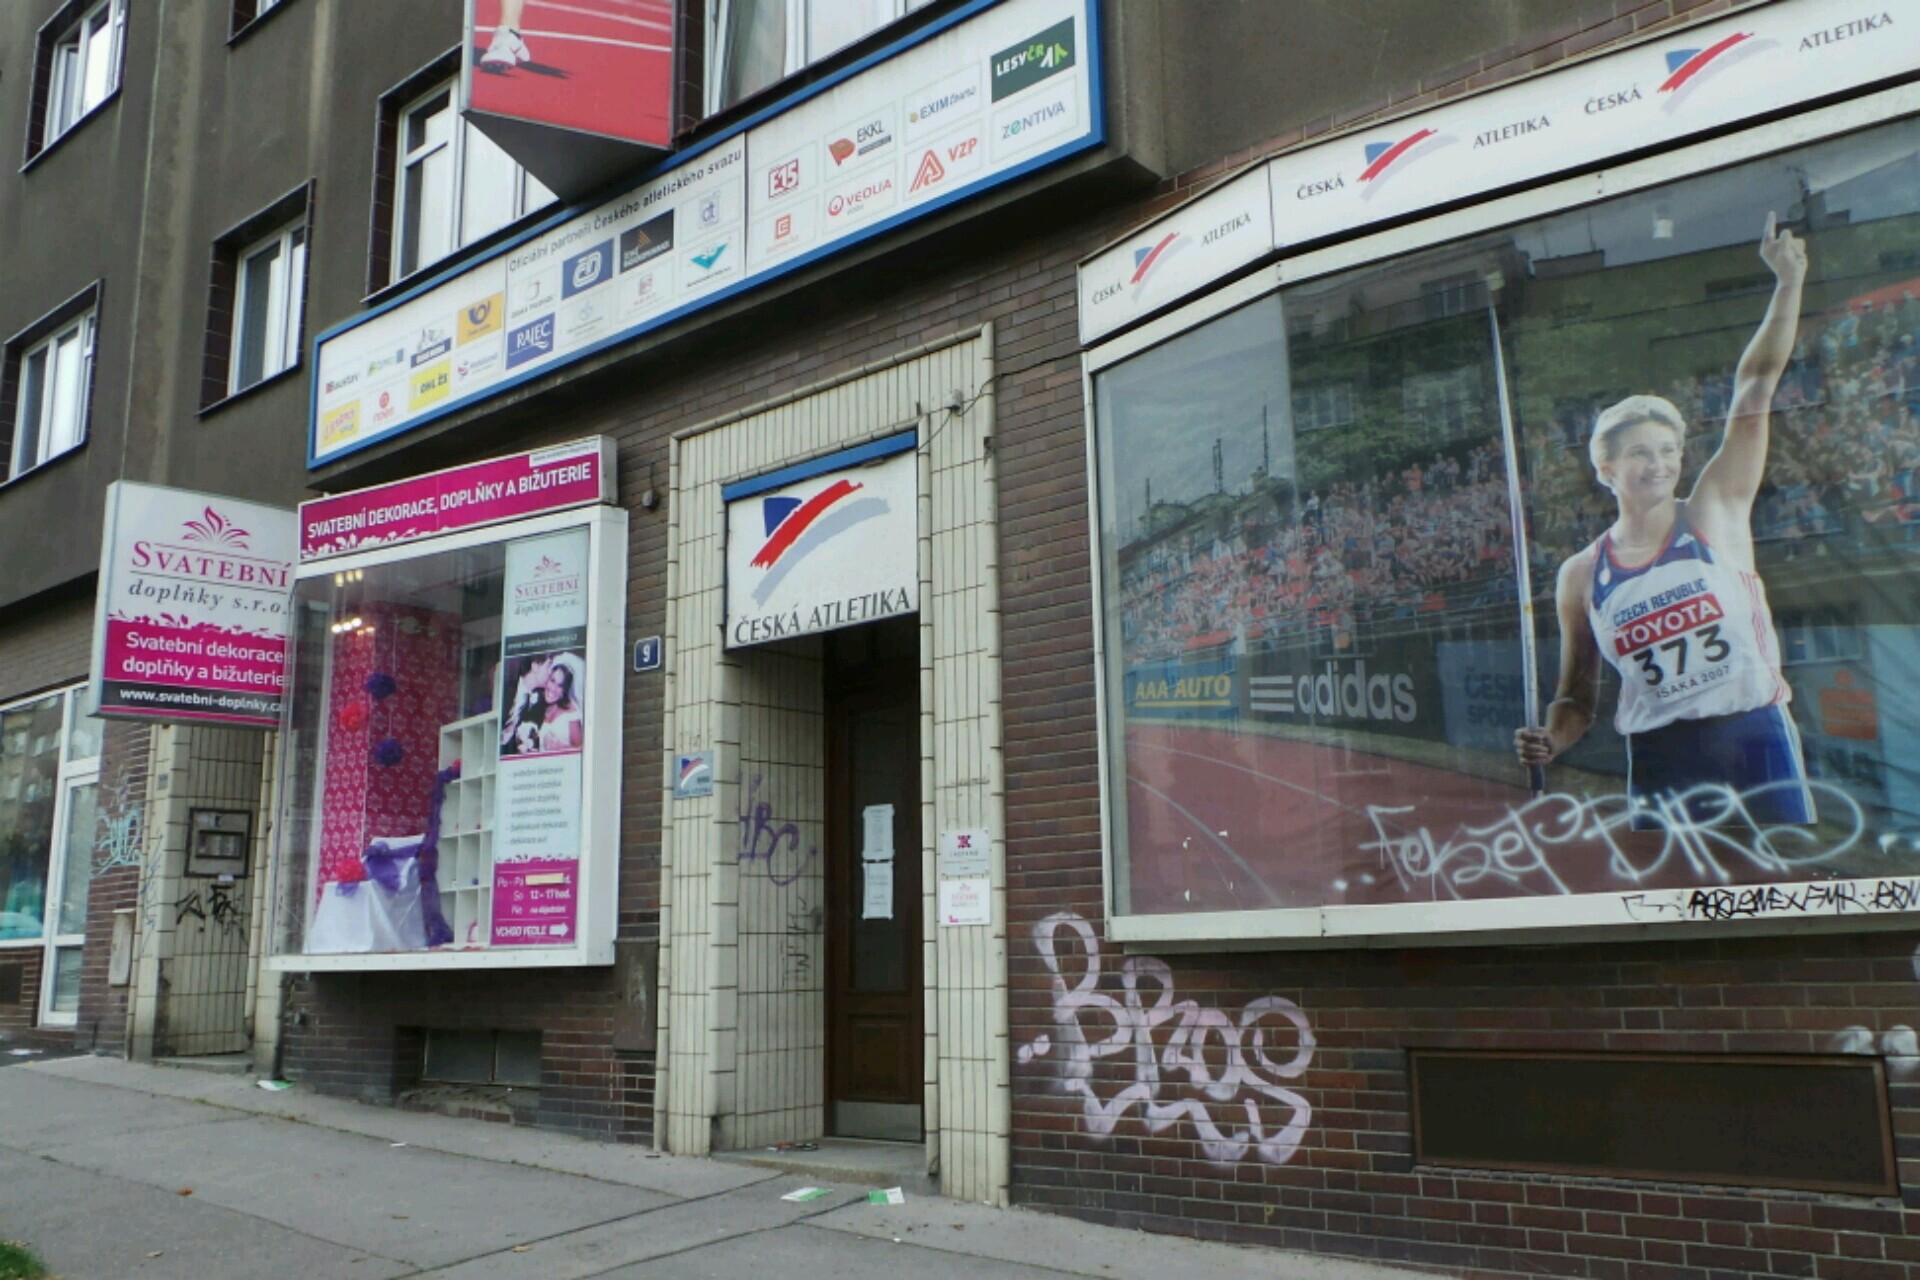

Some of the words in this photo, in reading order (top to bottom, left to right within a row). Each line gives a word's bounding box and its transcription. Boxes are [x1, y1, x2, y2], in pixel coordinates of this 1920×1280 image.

[1799, 12, 1893, 52] ATLETIKA
[1584, 84, 1642, 115] ČESKÁ
[1473, 115, 1550, 149] ATLETIKA
[948, 138, 977, 161] VZP
[594, 201, 640, 231] Českého
[643, 169, 704, 208] atletického
[707, 151, 742, 175] svazu
[846, 179, 892, 206] VEOLIA
[1296, 173, 1345, 200] ČESKÁ
[1201, 213, 1251, 247] ATLETIKA
[1092, 279, 1123, 305] ČESKÁ
[308, 507, 366, 538] SVATEBNÍ
[369, 497, 438, 526] DEKORACE,
[440, 479, 503, 511] DOPLŇKY
[506, 482, 516, 496] A
[518, 462, 591, 494] BIŽUTERIE
[129, 579, 224, 611] doplňky
[233, 597, 288, 615] s.r.o.
[1613, 601, 1649, 626] CZECH
[1652, 578, 1708, 609] REPUBLIC
[735, 603, 801, 645] ČESKÁ
[809, 586, 910, 629] ATLETIKA
[1616, 600, 1719, 650] TOYOTA
[126, 632, 202, 654] Svatební
[207, 642, 284, 664] dekorace
[642, 643, 651, 663] 9
[1633, 624, 1731, 686] 373
[122, 656, 194, 681] doplňky
[198, 667, 208, 679] a
[213, 664, 284, 686] bižuterie
[1136, 682, 1169, 700] AAA
[1174, 674, 1231, 699] AUTO
[1701, 665, 1730, 684] 2007
[1298, 659, 1418, 722] adidas
